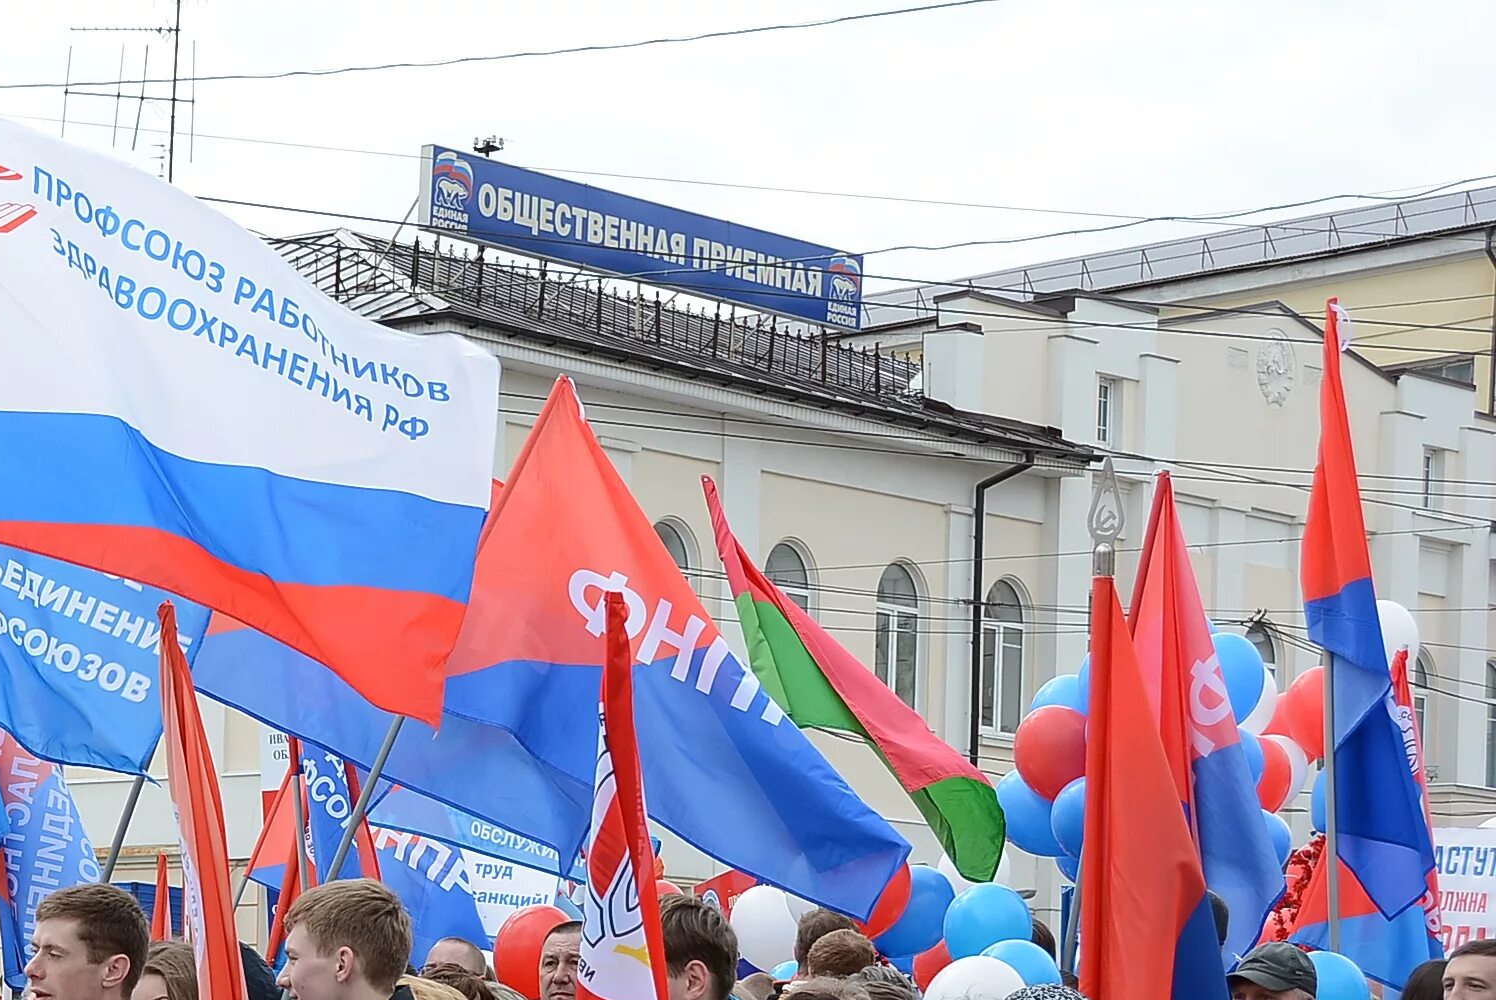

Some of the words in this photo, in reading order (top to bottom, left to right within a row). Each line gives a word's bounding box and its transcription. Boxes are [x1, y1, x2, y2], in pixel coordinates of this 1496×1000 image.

[433, 206, 468, 224] ЕДИНАЯ
[478, 183, 686, 266] ОБЩЕСТВЕННАЯ
[692, 236, 822, 297] ПРИЕМНАЯ
[32, 165, 225, 293] ПРОФСОЮЗ
[233, 276, 451, 402] РАБОТНИКОВ
[827, 301, 857, 317] ЕДИНАЯ
[827, 311, 857, 327] РОССИЯ
[49, 228, 373, 422] ЗДРАВООХРАНЕНИЯ
[381, 403, 429, 441] РФ
[475, 863, 513, 880] труд
